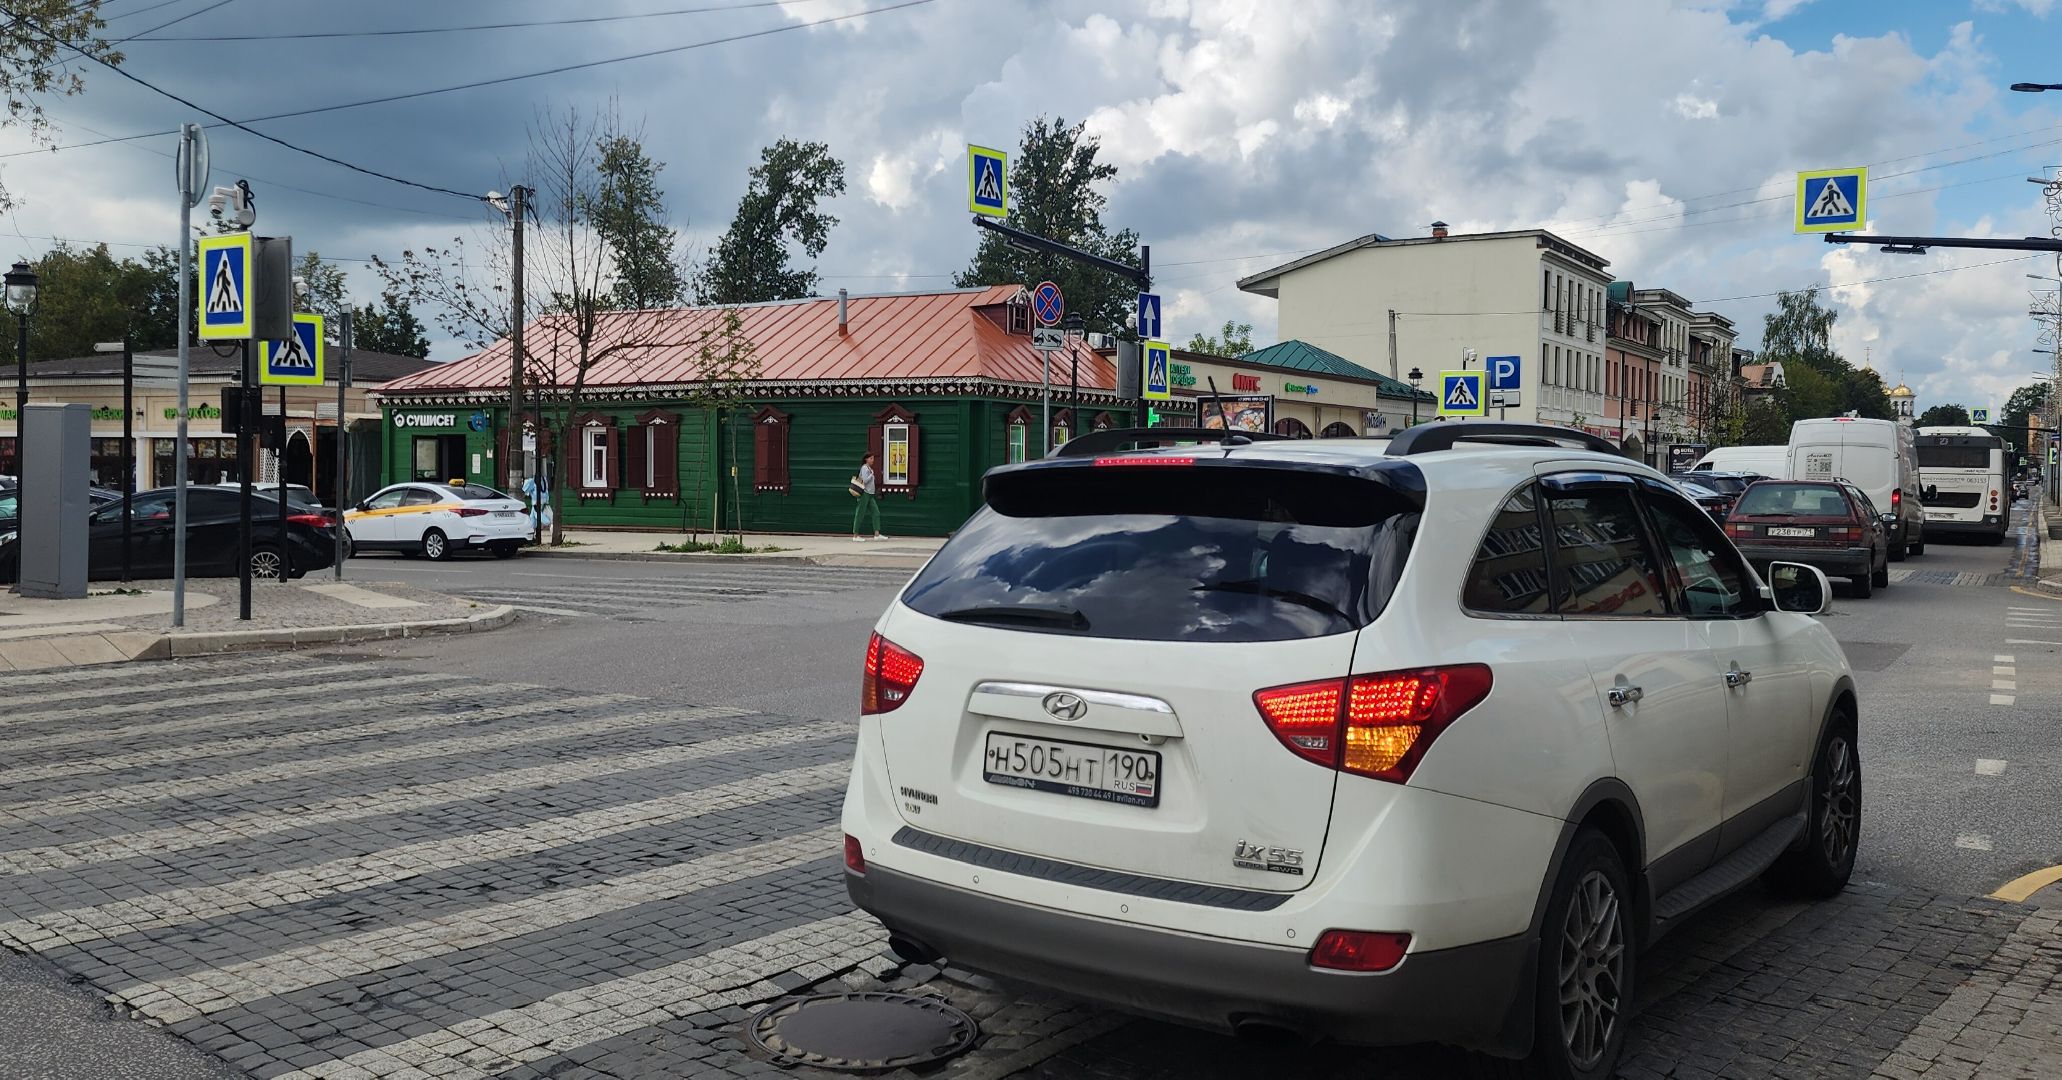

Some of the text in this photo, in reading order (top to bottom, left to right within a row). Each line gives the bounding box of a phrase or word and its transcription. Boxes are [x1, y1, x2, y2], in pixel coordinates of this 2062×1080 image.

[1495, 361, 1515, 387] P
[406, 414, 455, 427] СУШИСЕТ
[994, 742, 1149, 785] Н505НТ 190
[1113, 780, 1135, 791] RUS
